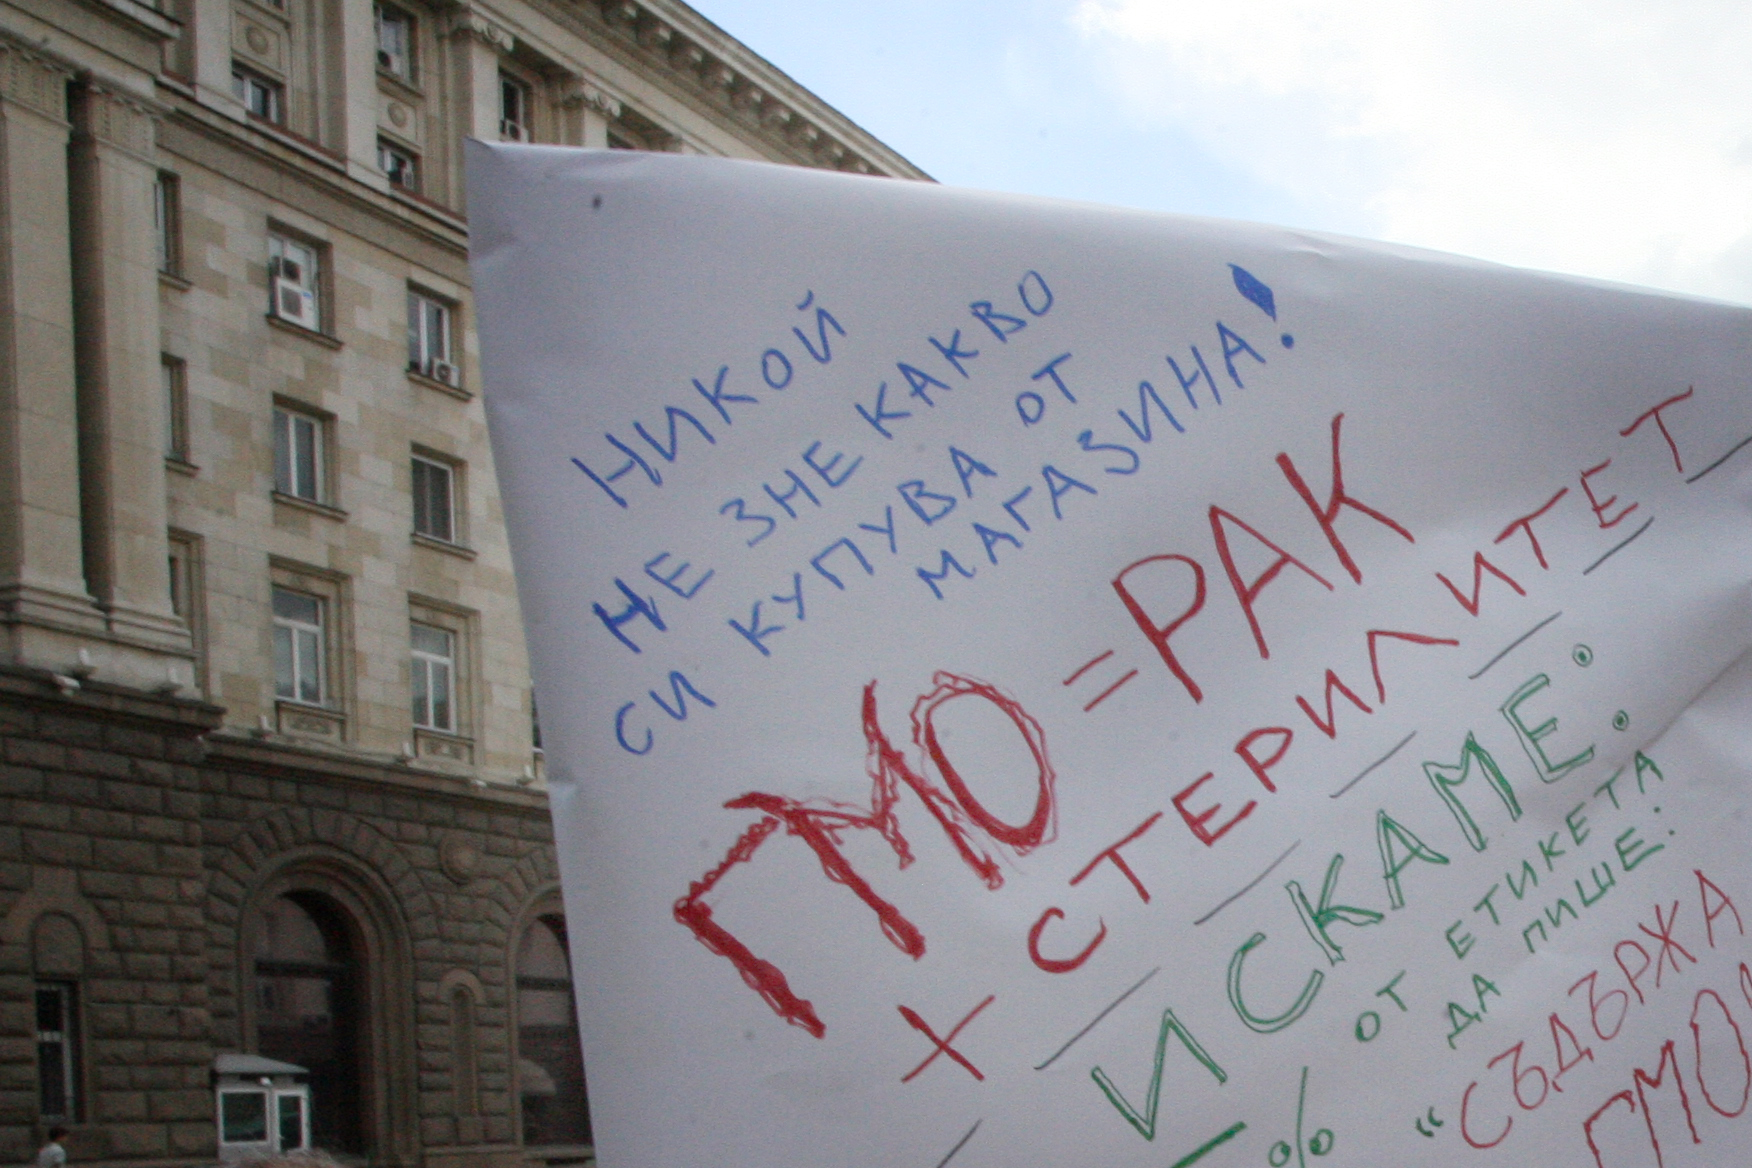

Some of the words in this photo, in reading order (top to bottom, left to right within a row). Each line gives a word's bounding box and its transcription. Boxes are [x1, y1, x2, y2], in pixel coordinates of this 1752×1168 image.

[571, 289, 846, 508] НИКОЙ
[592, 551, 715, 652] НЕ
[720, 440, 863, 546] ЗНЕ
[855, 269, 1054, 440] КАКВО
[614, 671, 717, 755] СИ
[728, 445, 997, 657] КУПУВА
[1015, 353, 1080, 427] ОТ
[916, 262, 1294, 599] МАГАЗИНА!
[1027, 385, 1694, 973] СТЕРИЛИТЕТ
[1354, 970, 1407, 1042] ОТ
[1445, 749, 1664, 959] ЕТИКЕТА
[1441, 973, 1501, 1050] ДА
